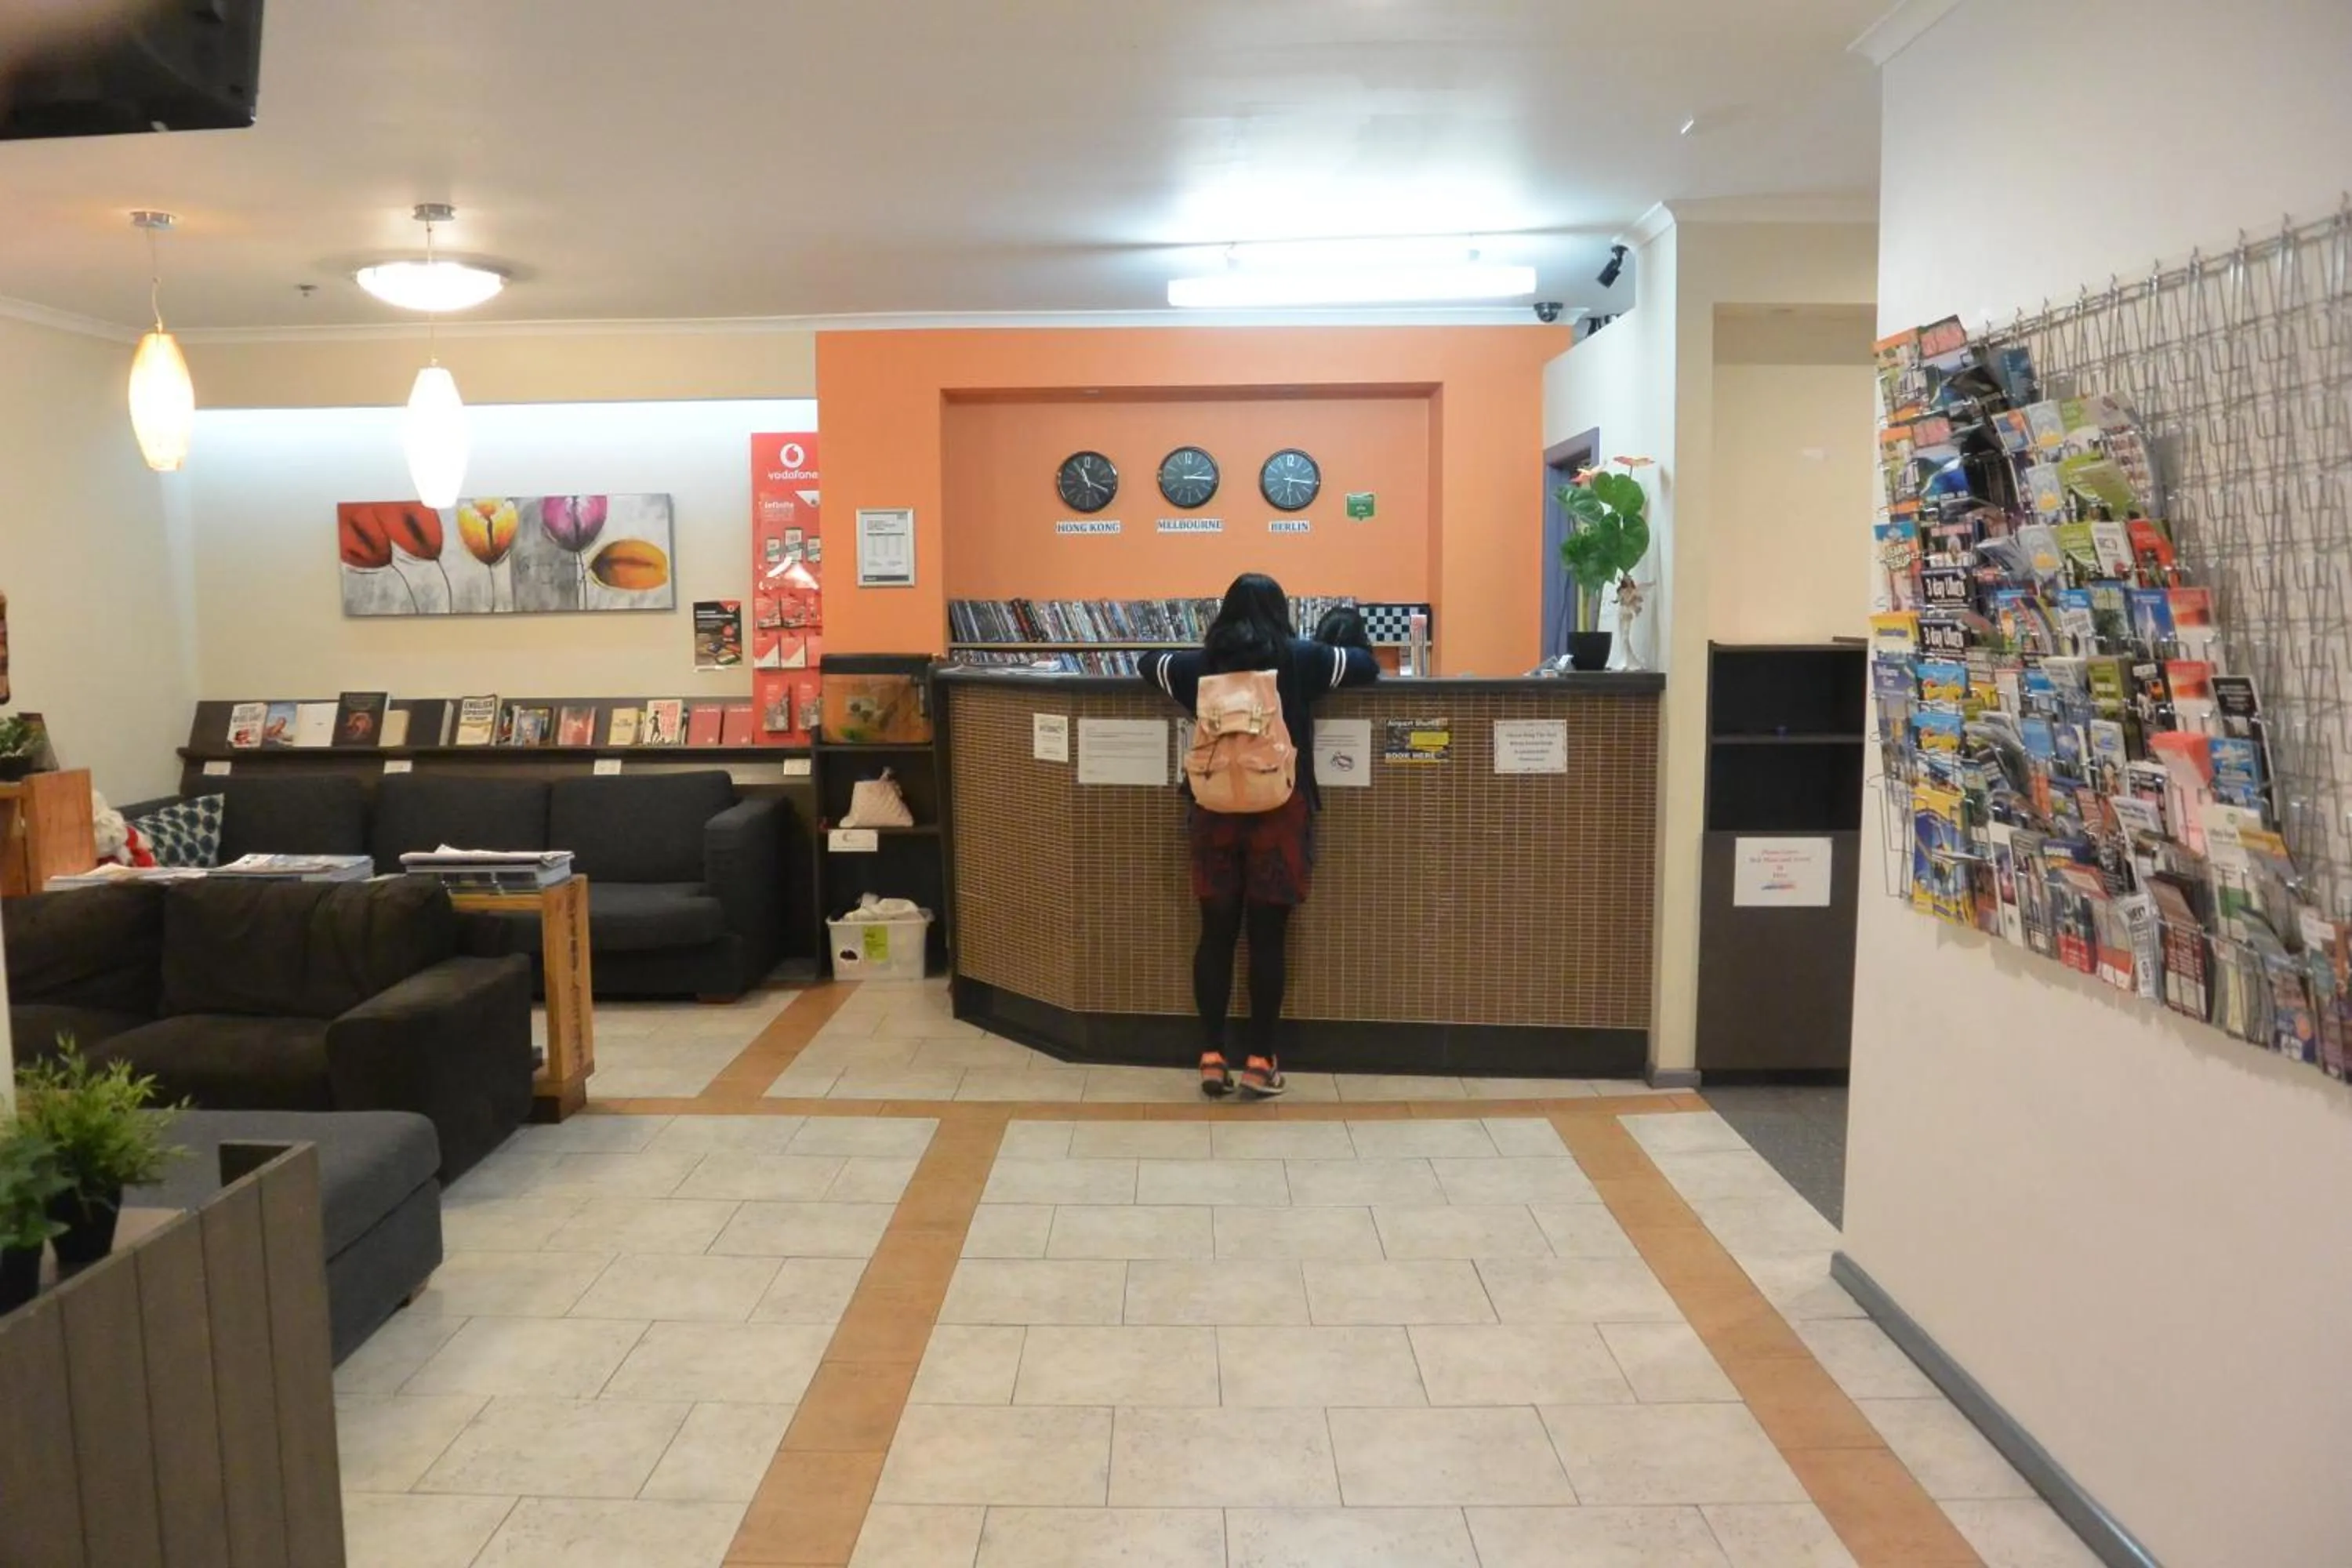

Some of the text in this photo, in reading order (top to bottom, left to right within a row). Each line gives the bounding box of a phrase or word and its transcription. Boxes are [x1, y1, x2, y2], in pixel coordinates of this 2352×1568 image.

[1287, 455, 1294, 466] 12
[768, 470, 818, 480] vodafone
[1058, 521, 1119, 532] HONG KONG
[1159, 520, 1221, 530] MELBOURNE
[1271, 522, 1308, 532] BERLIN
